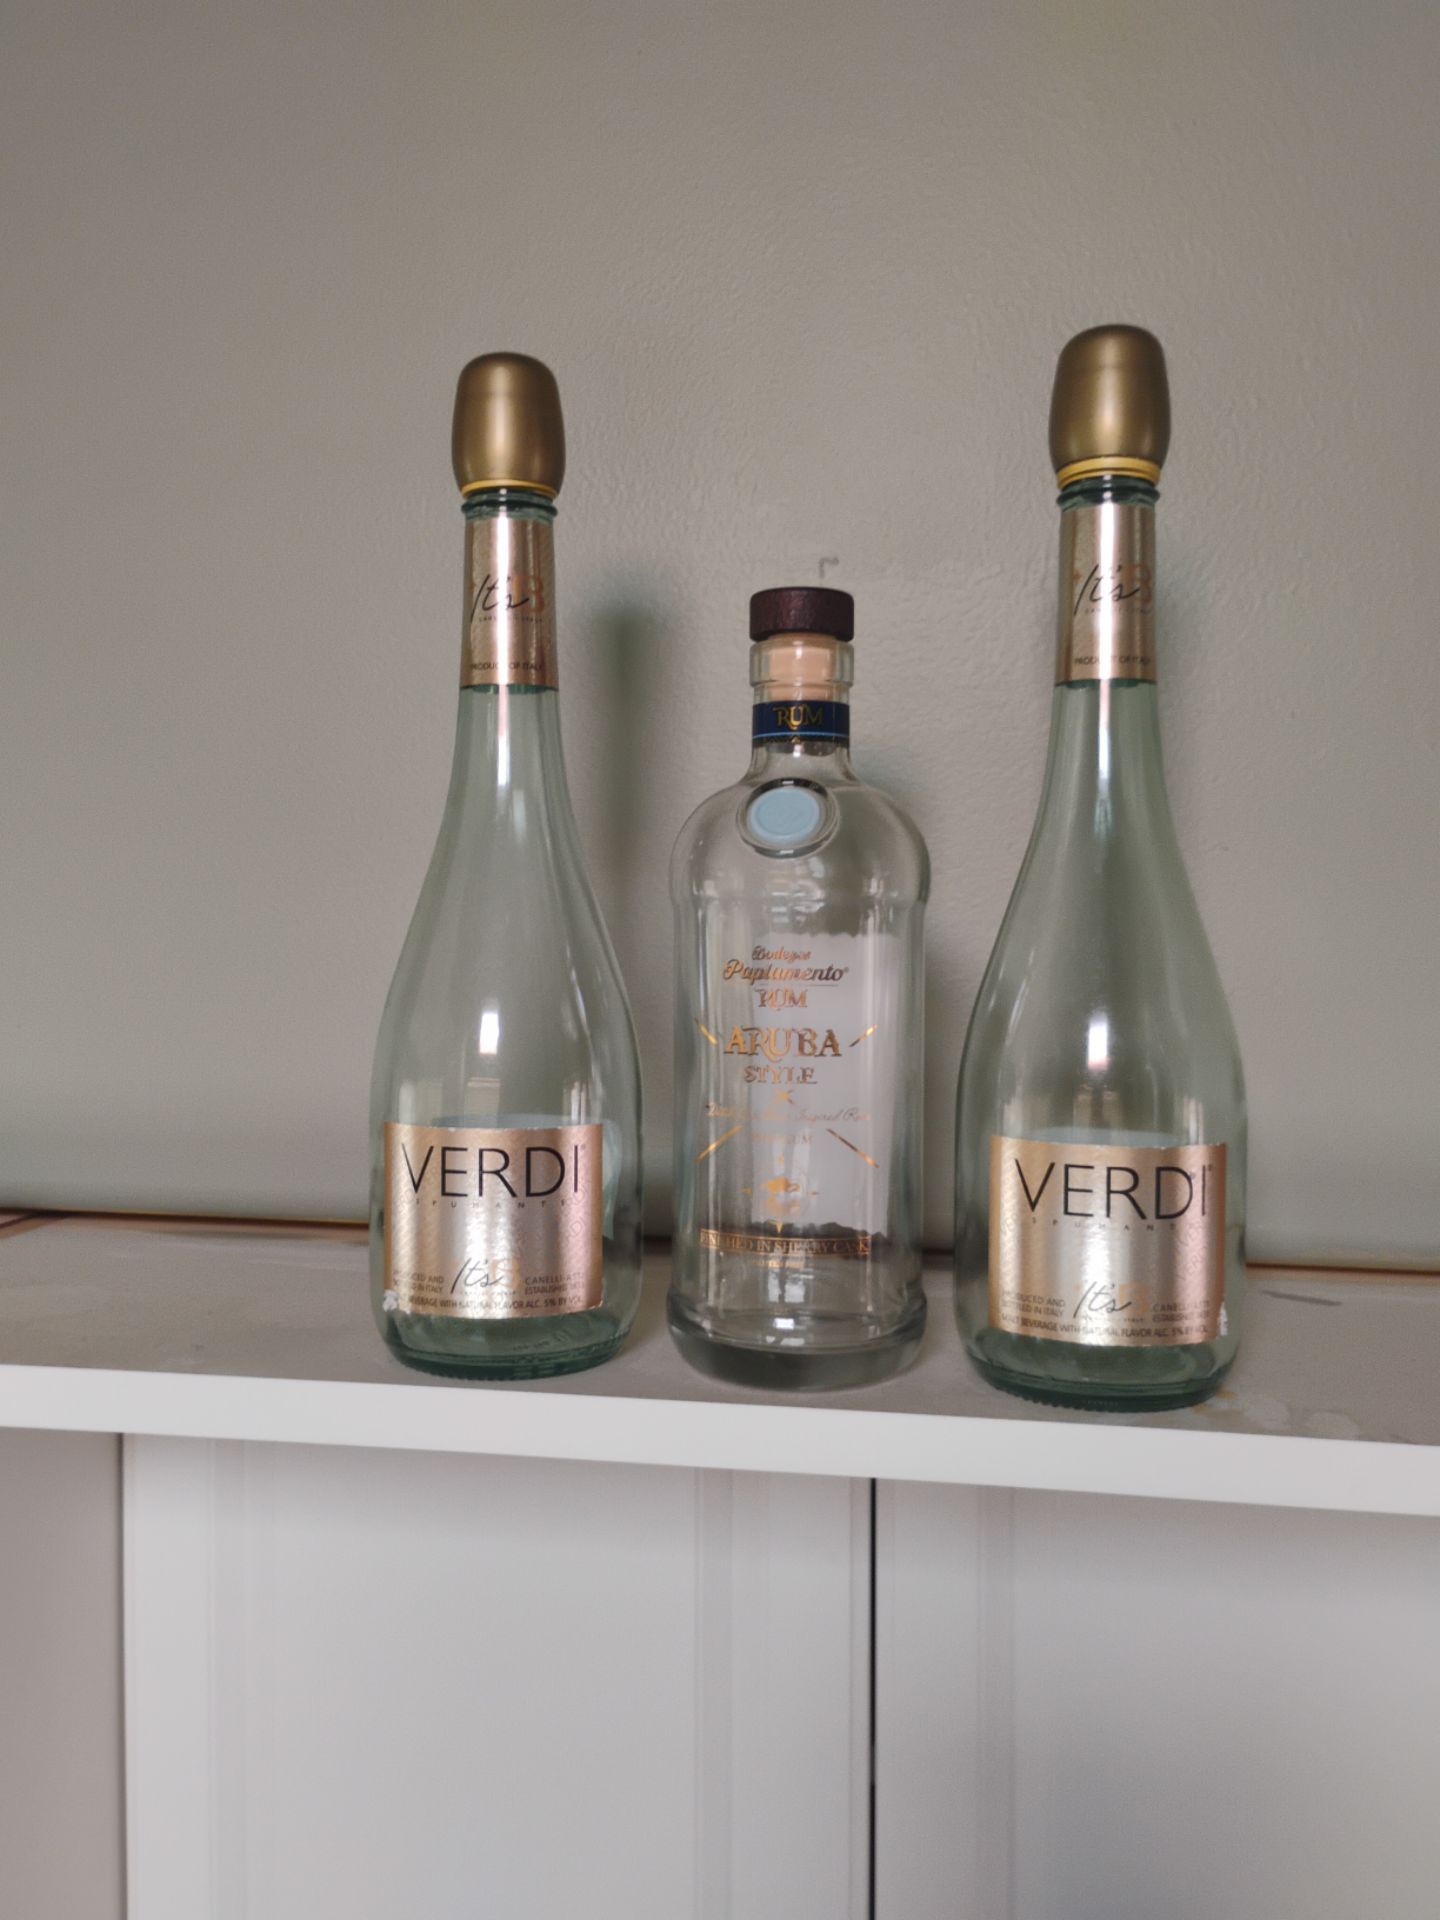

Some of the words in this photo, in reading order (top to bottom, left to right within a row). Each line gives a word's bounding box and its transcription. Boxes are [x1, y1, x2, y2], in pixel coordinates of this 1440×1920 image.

[772, 704, 825, 731] RUM
[755, 988, 809, 1012] RUM
[724, 1024, 843, 1063] ARUBA
[744, 1065, 818, 1084] STYLE
[401, 1143, 584, 1199] VERDI
[1015, 1158, 1211, 1219] VERDI
